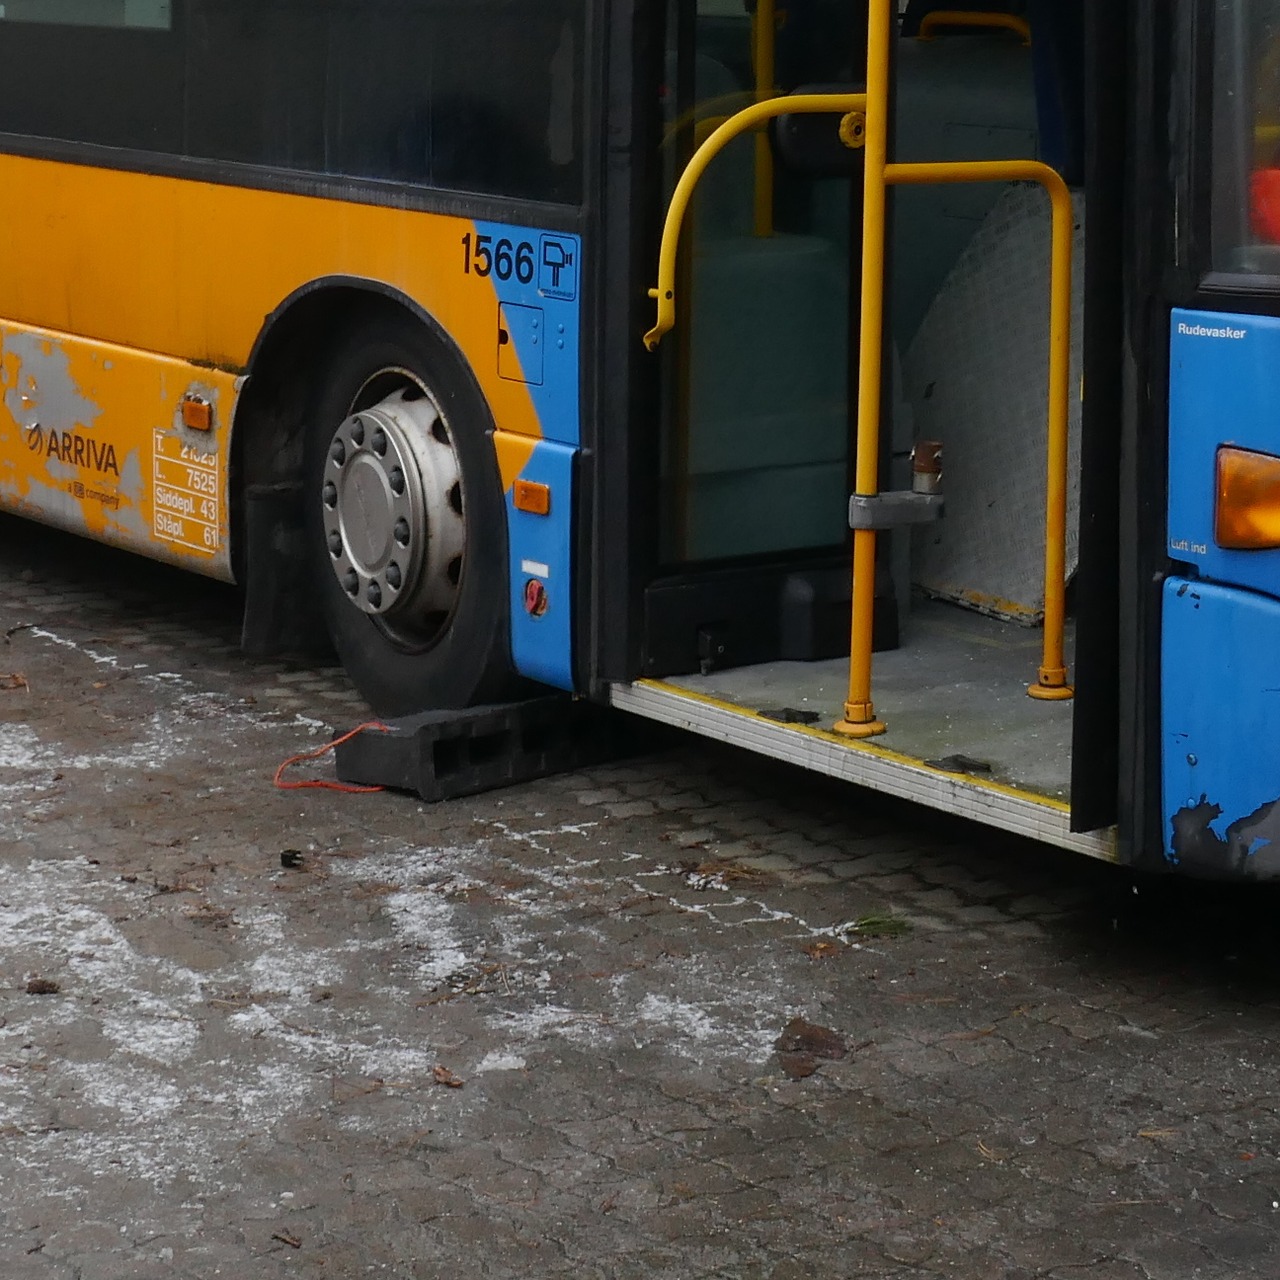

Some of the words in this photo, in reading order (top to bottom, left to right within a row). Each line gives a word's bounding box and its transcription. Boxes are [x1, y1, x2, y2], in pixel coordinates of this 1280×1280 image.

[461, 233, 534, 284] 1566
[1177, 322, 1247, 339] Rudevasker
[47, 428, 119, 476] ARRIVA
[186, 468, 216, 494] 7525
[86, 489, 120, 510] company
[156, 487, 195, 515] Siddepl.
[200, 500, 216, 521] 43
[156, 514, 185, 538] Ståpl.
[203, 527, 216, 548] 61
[1171, 538, 1189, 551] Luft
[1190, 541, 1206, 554] ind
